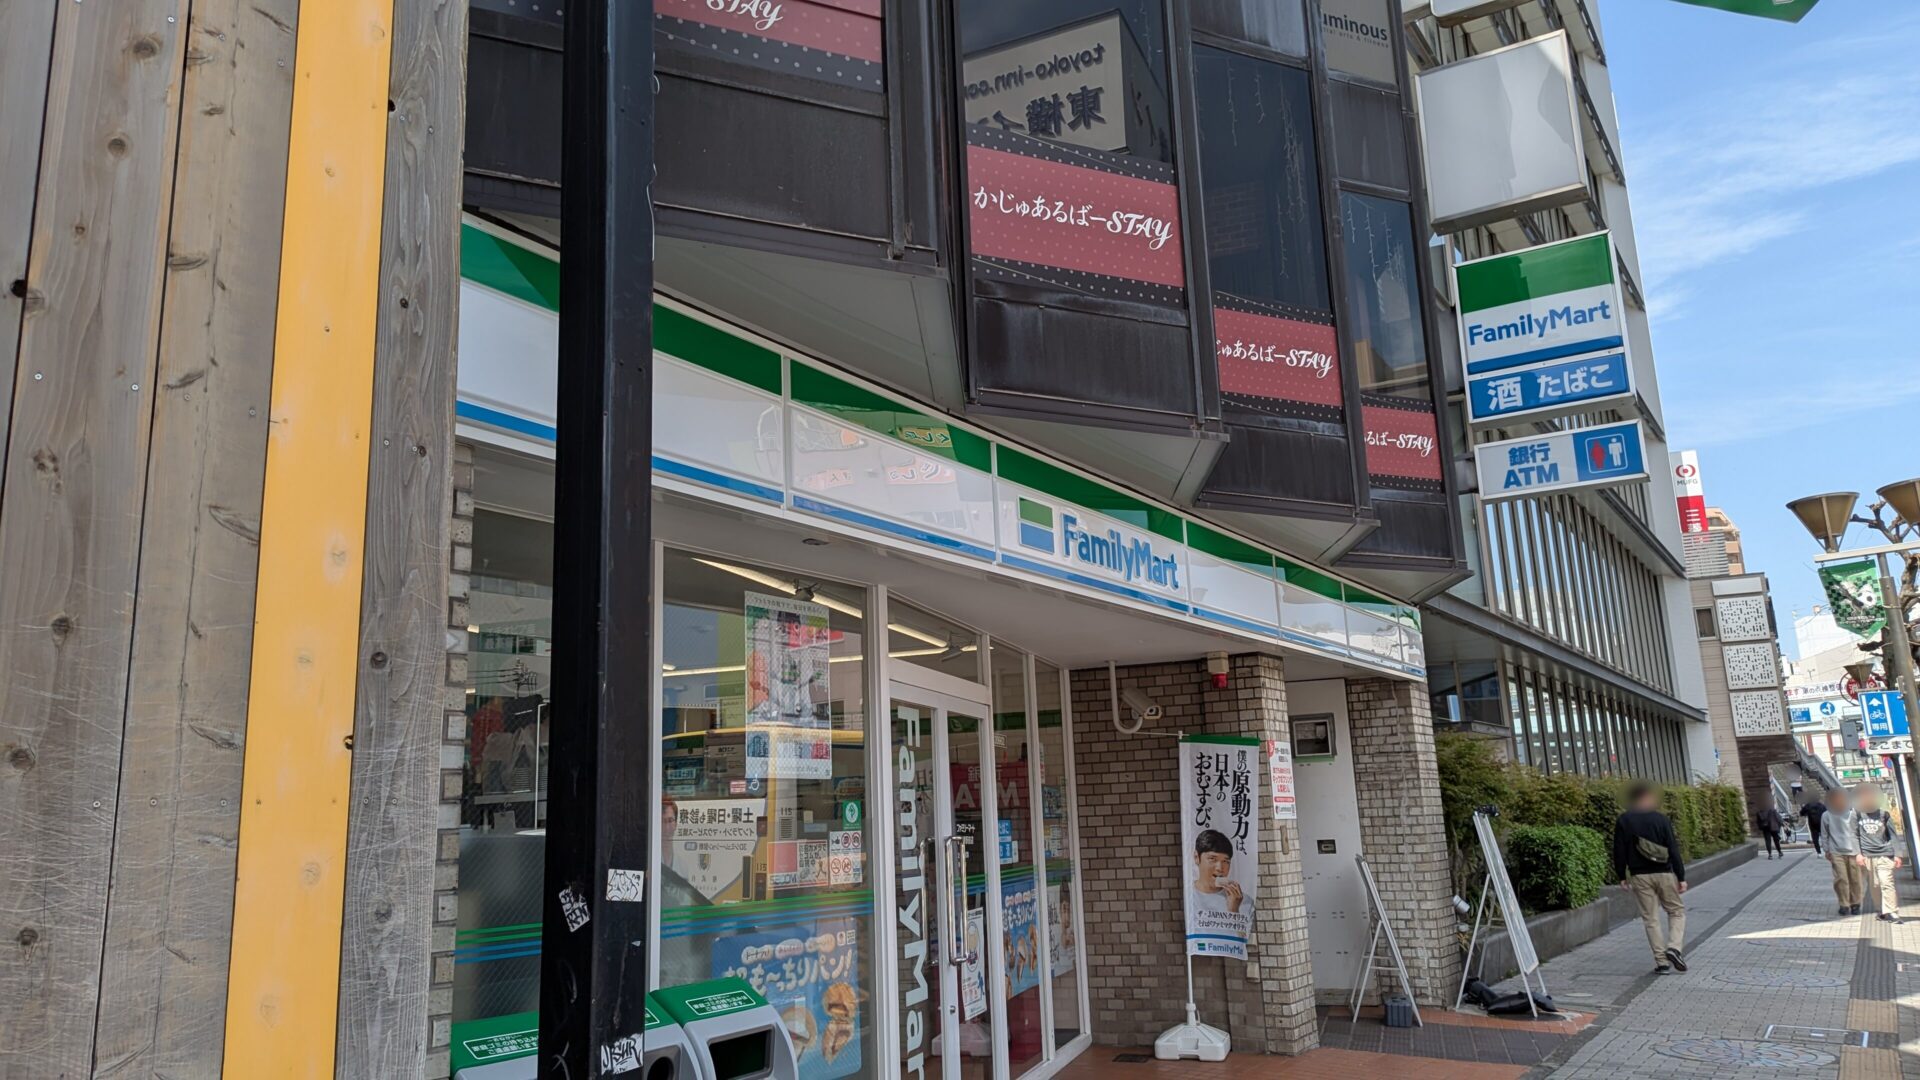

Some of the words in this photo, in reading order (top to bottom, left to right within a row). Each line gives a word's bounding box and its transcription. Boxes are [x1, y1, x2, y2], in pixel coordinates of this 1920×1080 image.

[1469, 301, 1611, 345] FamilyMart
[1486, 376, 1524, 411] 酒
[1537, 364, 1613, 399] たばこ
[1364, 431, 1434, 457] るばーSTAY
[1508, 442, 1551, 467] 銀行
[1503, 463, 1560, 490] ATM
[1062, 513, 1179, 589] FamilyMart
[1194, 752, 1213, 829] おむすび。
[1213, 753, 1230, 802] 日本の
